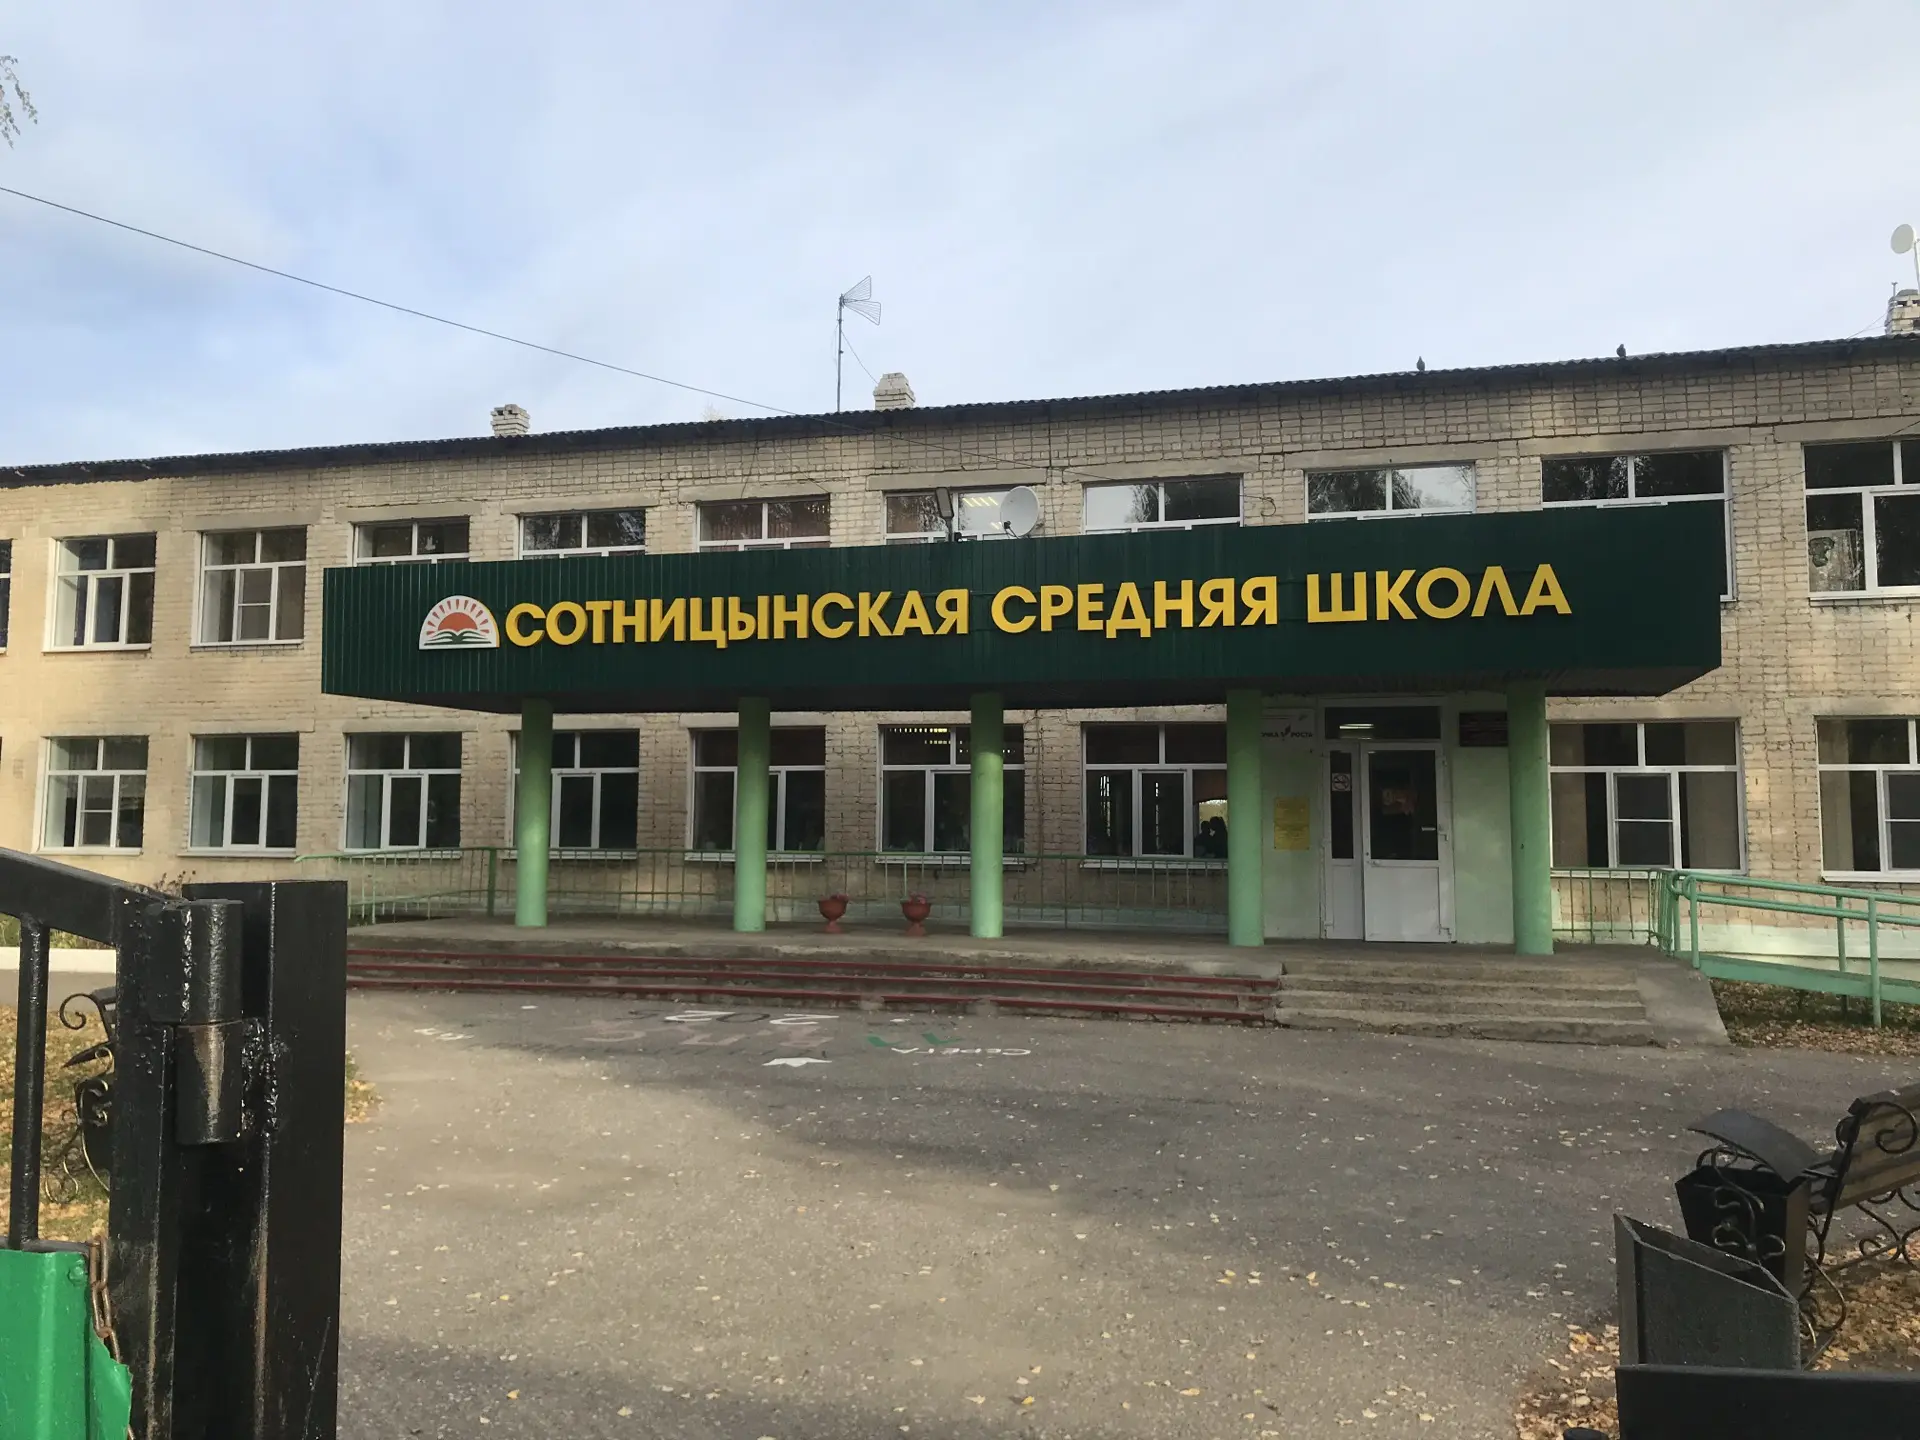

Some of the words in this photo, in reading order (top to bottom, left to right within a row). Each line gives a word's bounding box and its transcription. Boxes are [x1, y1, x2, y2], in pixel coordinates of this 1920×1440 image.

[505, 587, 970, 649] СОТНИЦЫНСКАЯ
[991, 575, 1279, 639] СРЕДНЯЯ
[1306, 563, 1572, 624] ШКОЛА
